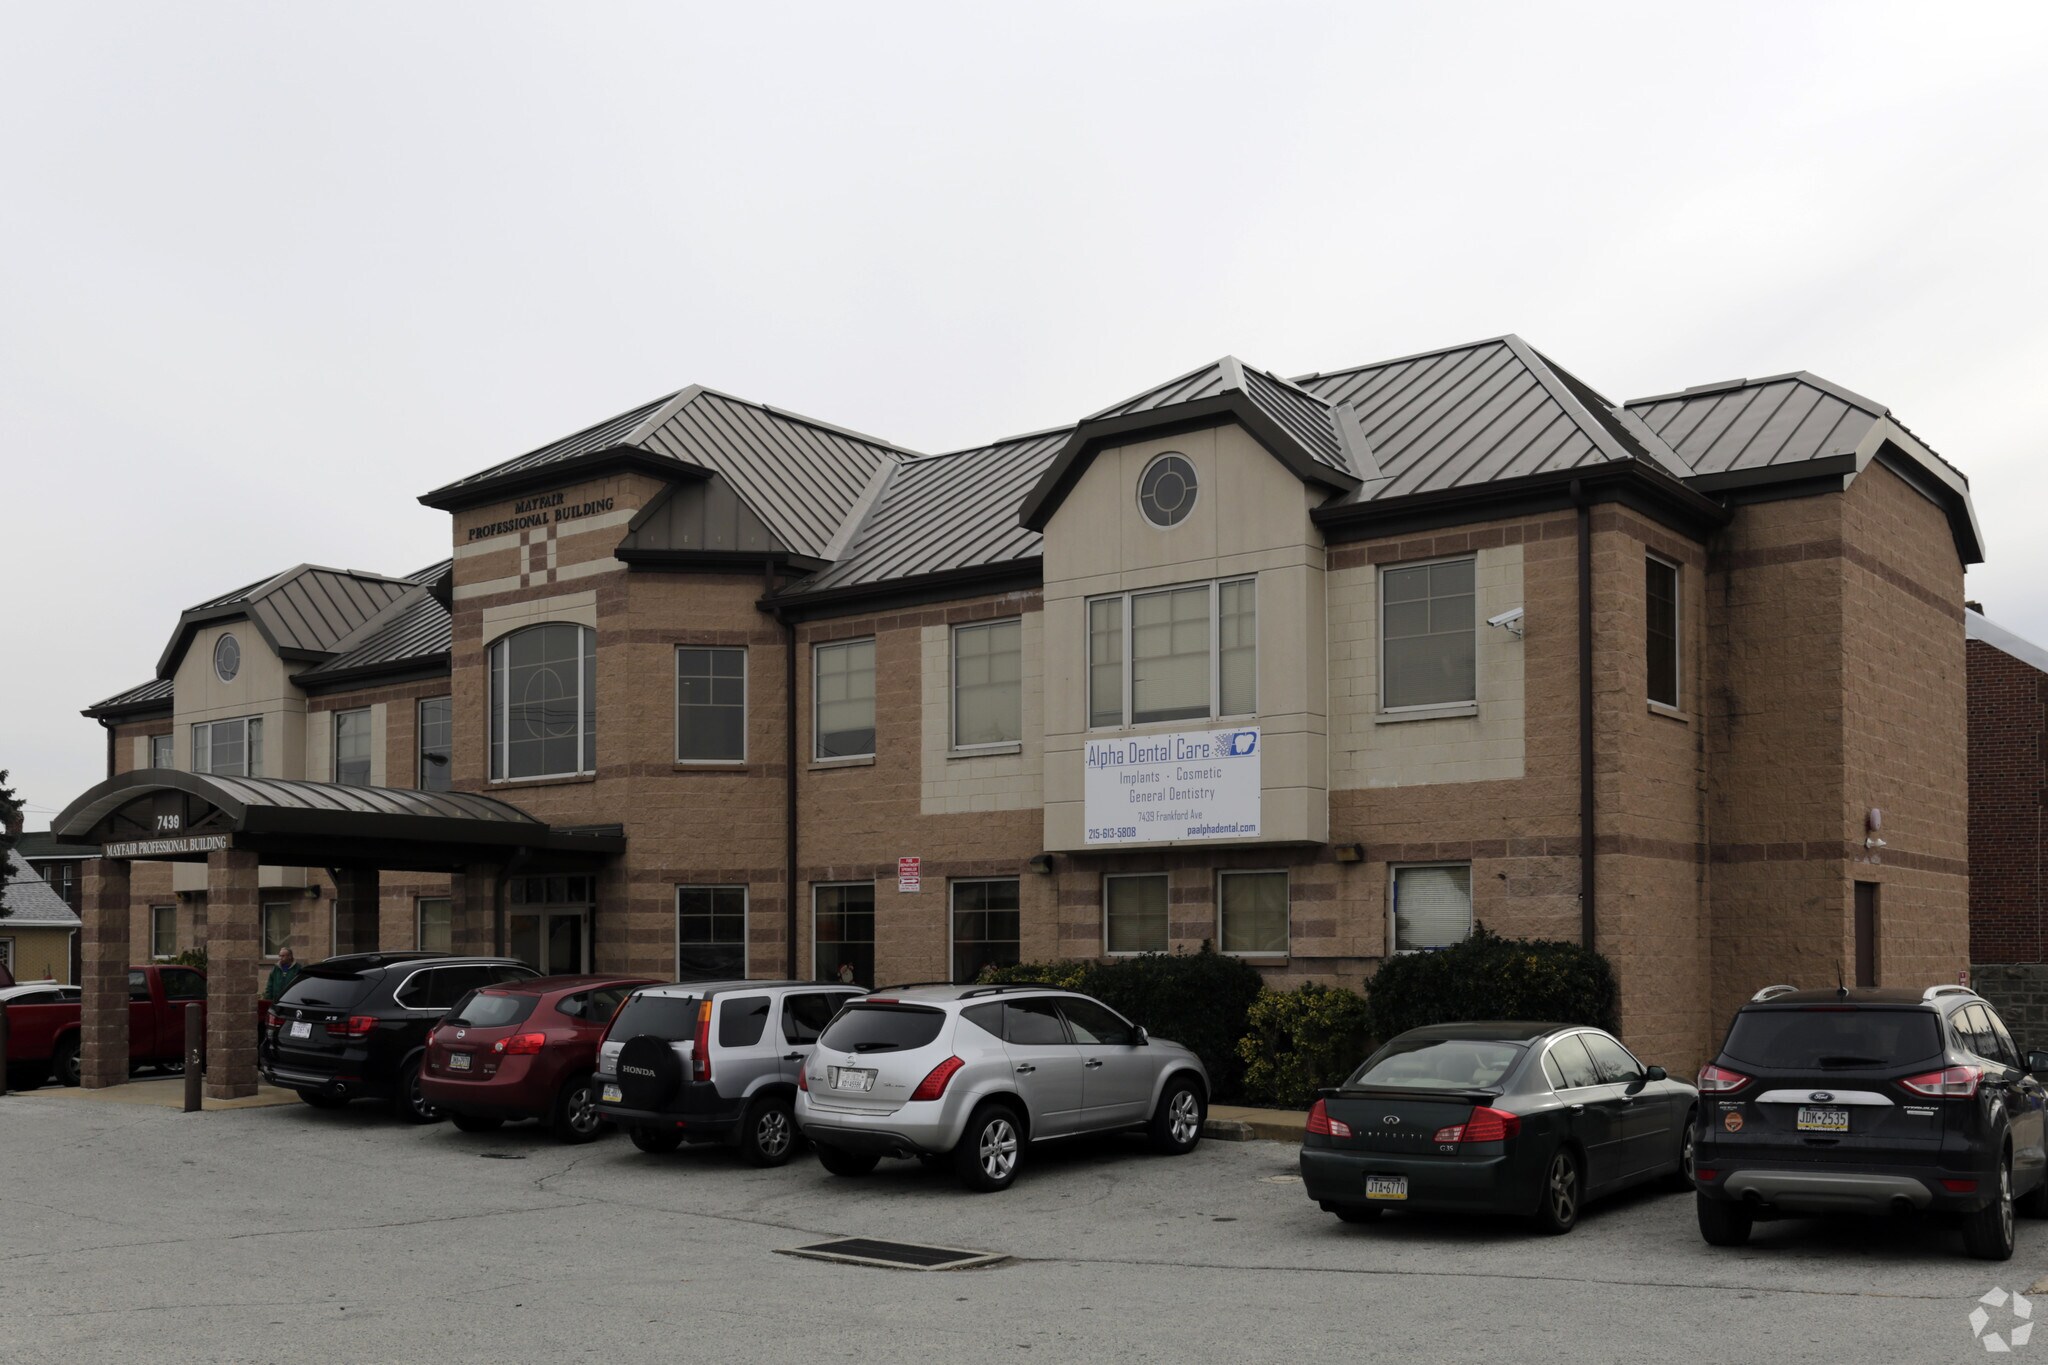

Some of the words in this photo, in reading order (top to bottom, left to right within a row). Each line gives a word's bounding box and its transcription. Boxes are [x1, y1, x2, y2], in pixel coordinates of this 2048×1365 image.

[515, 493, 564, 514] MAYFAIR
[468, 512, 549, 541] PROFESSIONAL
[554, 497, 614, 522] BUILDING
[1088, 744, 1124, 770] Alpha
[1129, 739, 1171, 764] Dental
[1176, 738, 1210, 760] Care
[1119, 771, 1160, 786] Implants
[1176, 766, 1222, 781] Cosmetic
[1129, 788, 1166, 803] General
[1169, 786, 1215, 801] Dentistry
[157, 814, 180, 830] 7439
[1156, 809, 1189, 821] Frankford
[1190, 809, 1203, 820] Ave
[1187, 822, 1256, 836] paalphadental.com
[106, 842, 138, 857] MAYFAIR
[138, 838, 189, 855] PROFESSIONAL
[189, 835, 227, 850] BUILDING
[622, 1065, 656, 1077] HONDA
